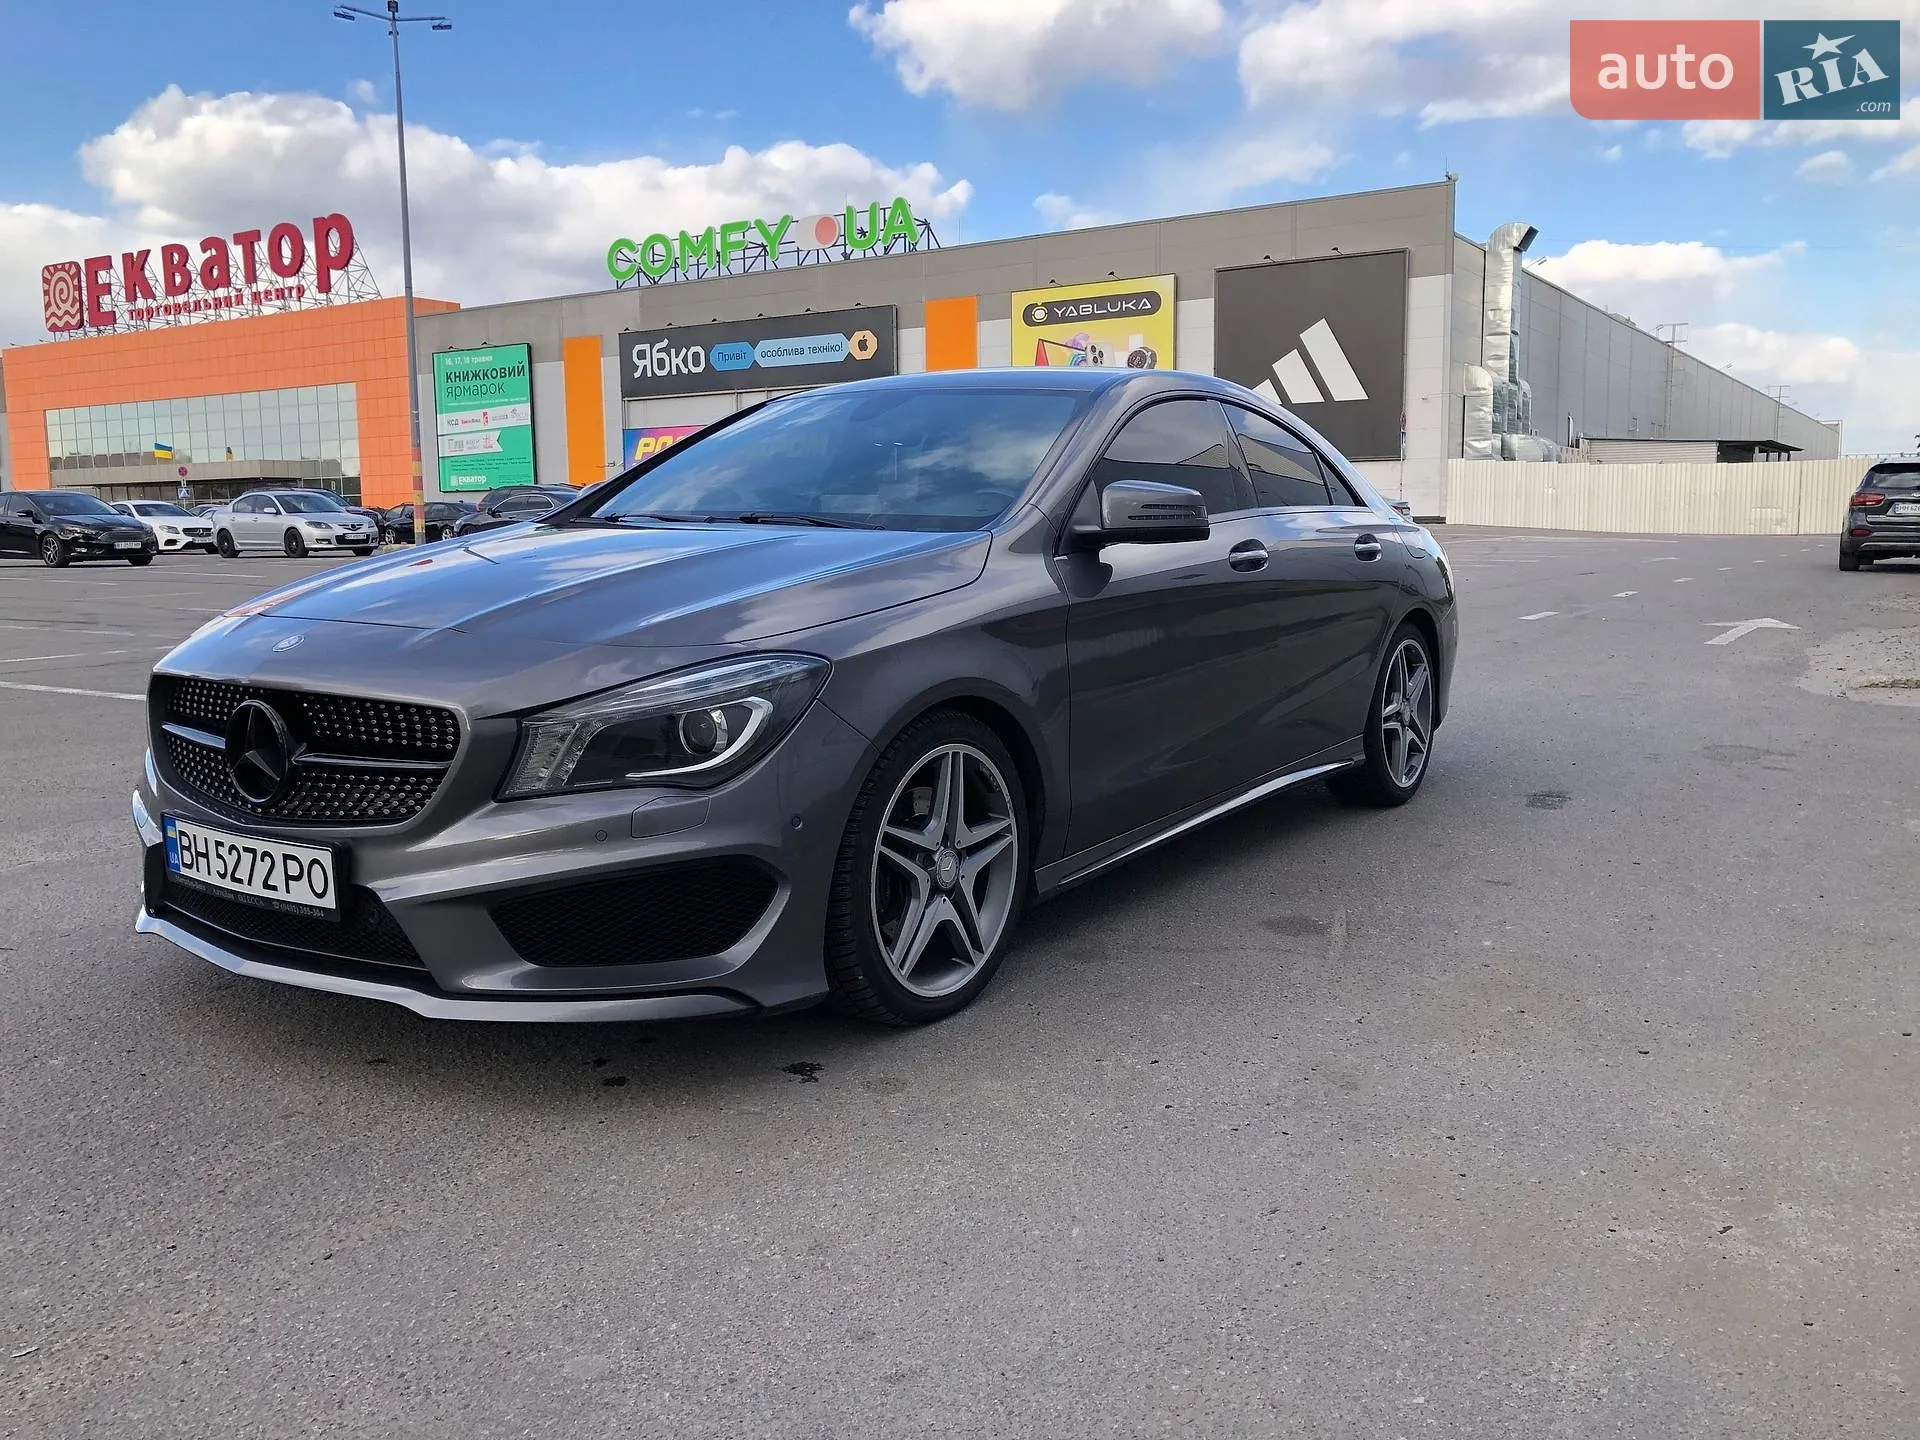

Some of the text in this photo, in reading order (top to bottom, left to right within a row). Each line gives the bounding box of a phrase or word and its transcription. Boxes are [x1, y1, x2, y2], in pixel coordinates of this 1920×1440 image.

[607, 197, 919, 281] COMFY UA
[84, 213, 354, 328] Екватор
[127, 284, 305, 321] торговельний центр
[1054, 298, 1152, 318] YABLUKA
[632, 338, 843, 379] Ябко Привіт особлива техніко!
[446, 382, 505, 400] ярмарок
[169, 850, 179, 865] UA
[178, 829, 211, 876] BH
[215, 839, 278, 893] 5272
[282, 852, 328, 899] PO
